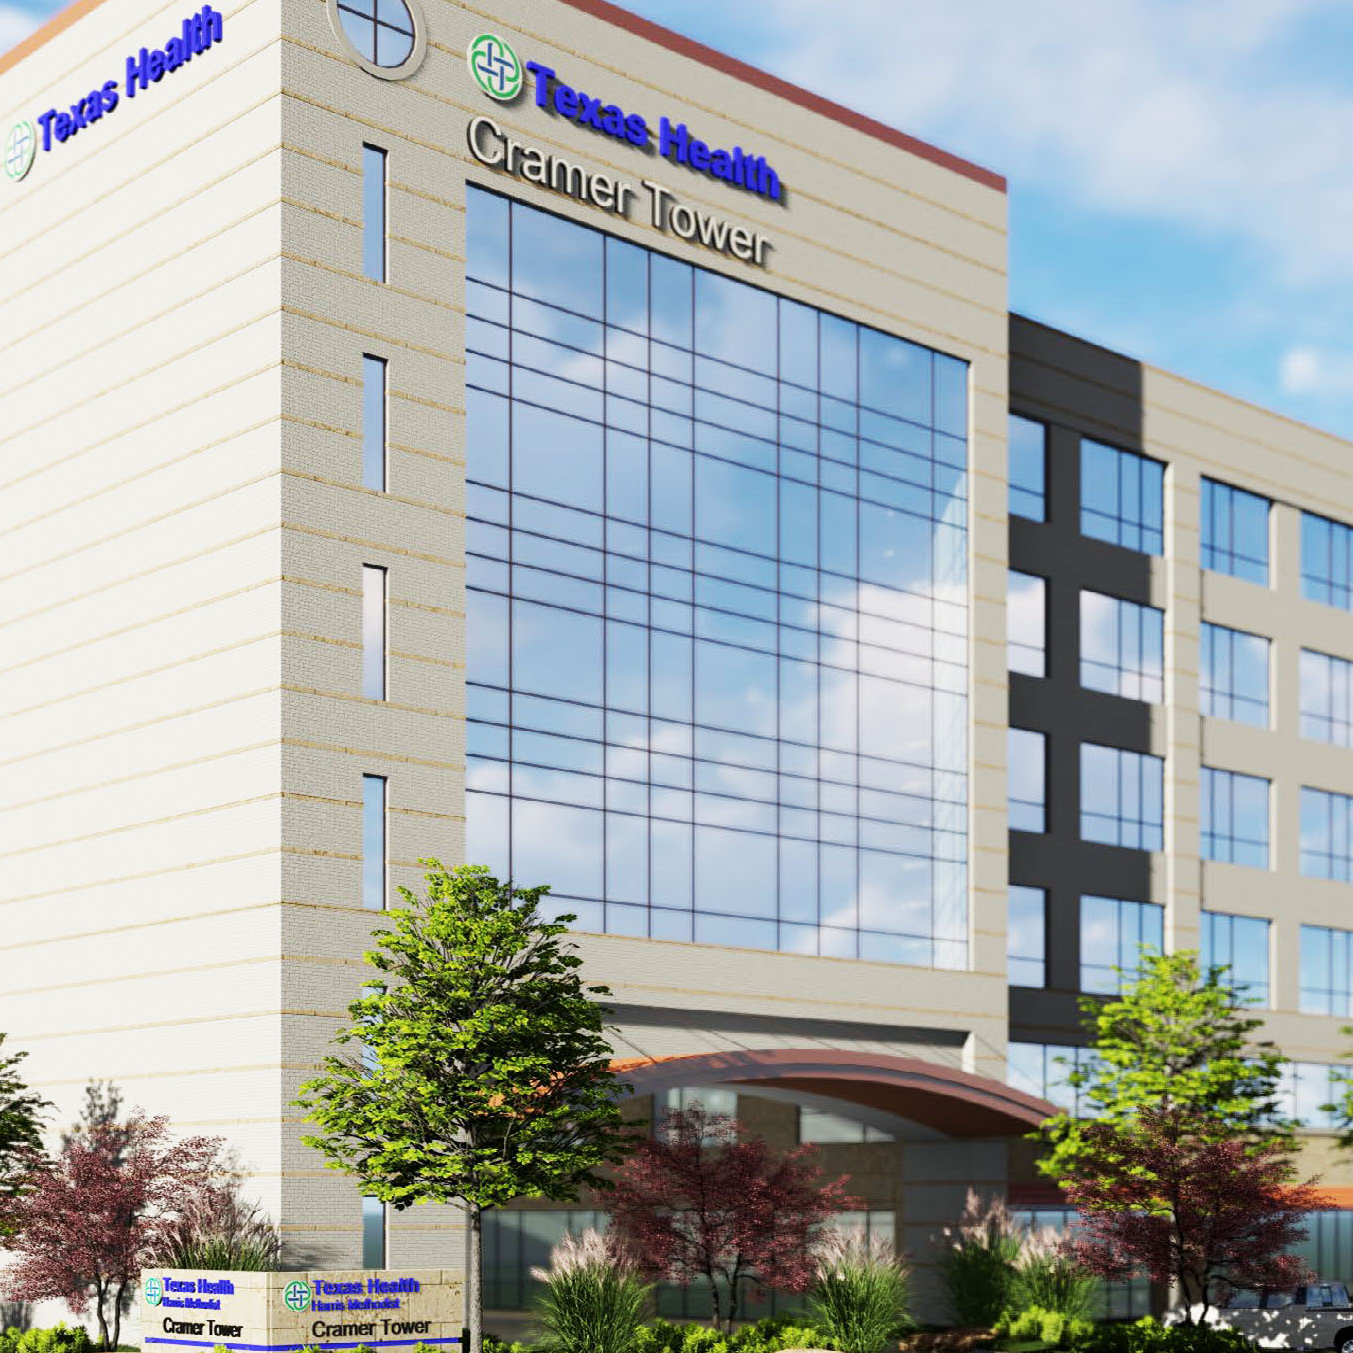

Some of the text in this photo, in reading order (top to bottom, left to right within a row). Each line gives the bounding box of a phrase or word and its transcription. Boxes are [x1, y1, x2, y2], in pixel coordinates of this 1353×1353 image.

[37, 4, 223, 152] Texas Health
[526, 60, 781, 199] Texas Health
[467, 115, 776, 264] Cramer Tower
[162, 1277, 235, 1295] Texas Health
[312, 1277, 420, 1296] Texas Health
[311, 1297, 401, 1312] Harris Methodist
[163, 1317, 244, 1337] Cramer Tower
[312, 1318, 432, 1338] Cramer Tower
